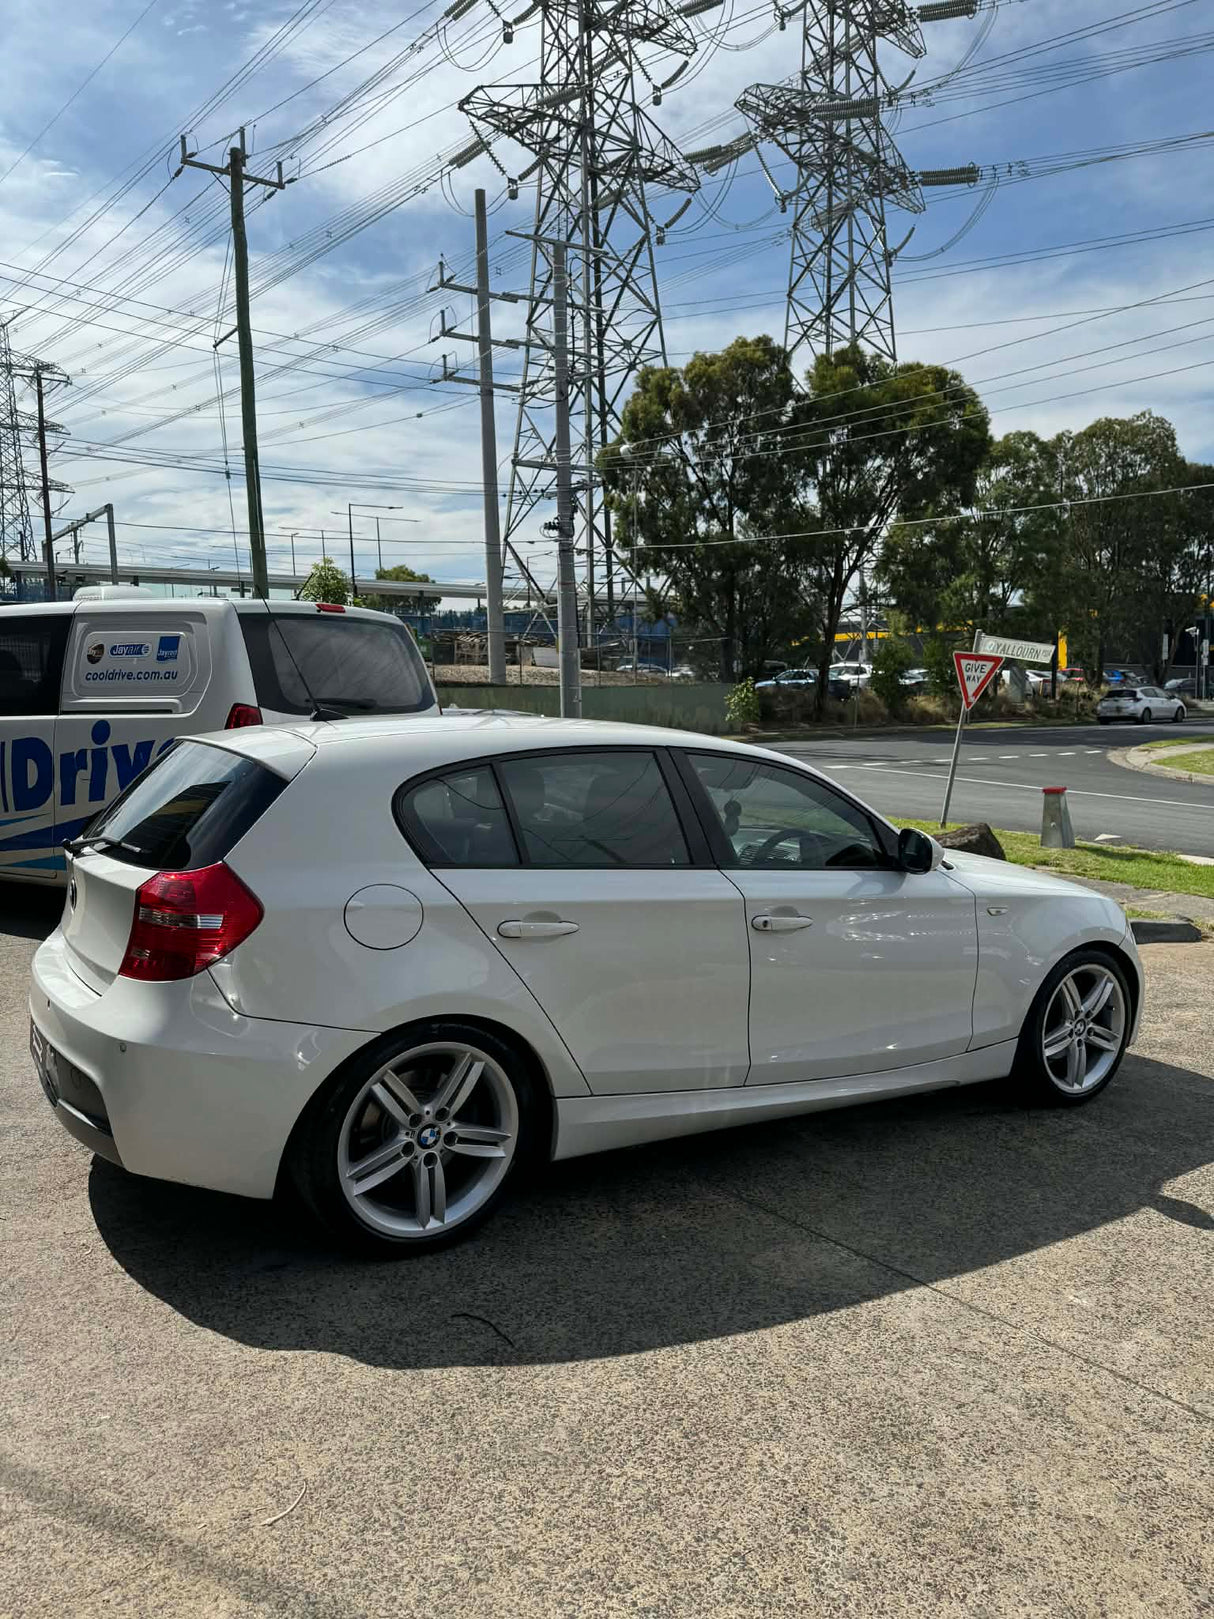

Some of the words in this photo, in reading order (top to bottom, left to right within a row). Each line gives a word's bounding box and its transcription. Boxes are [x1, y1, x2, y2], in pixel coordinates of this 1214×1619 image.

[996, 643, 1042, 660] YALLOURN
[965, 663, 986, 673] GIVE
[85, 669, 178, 681] cooldrive.com.au
[966, 674, 982, 683] WAY
